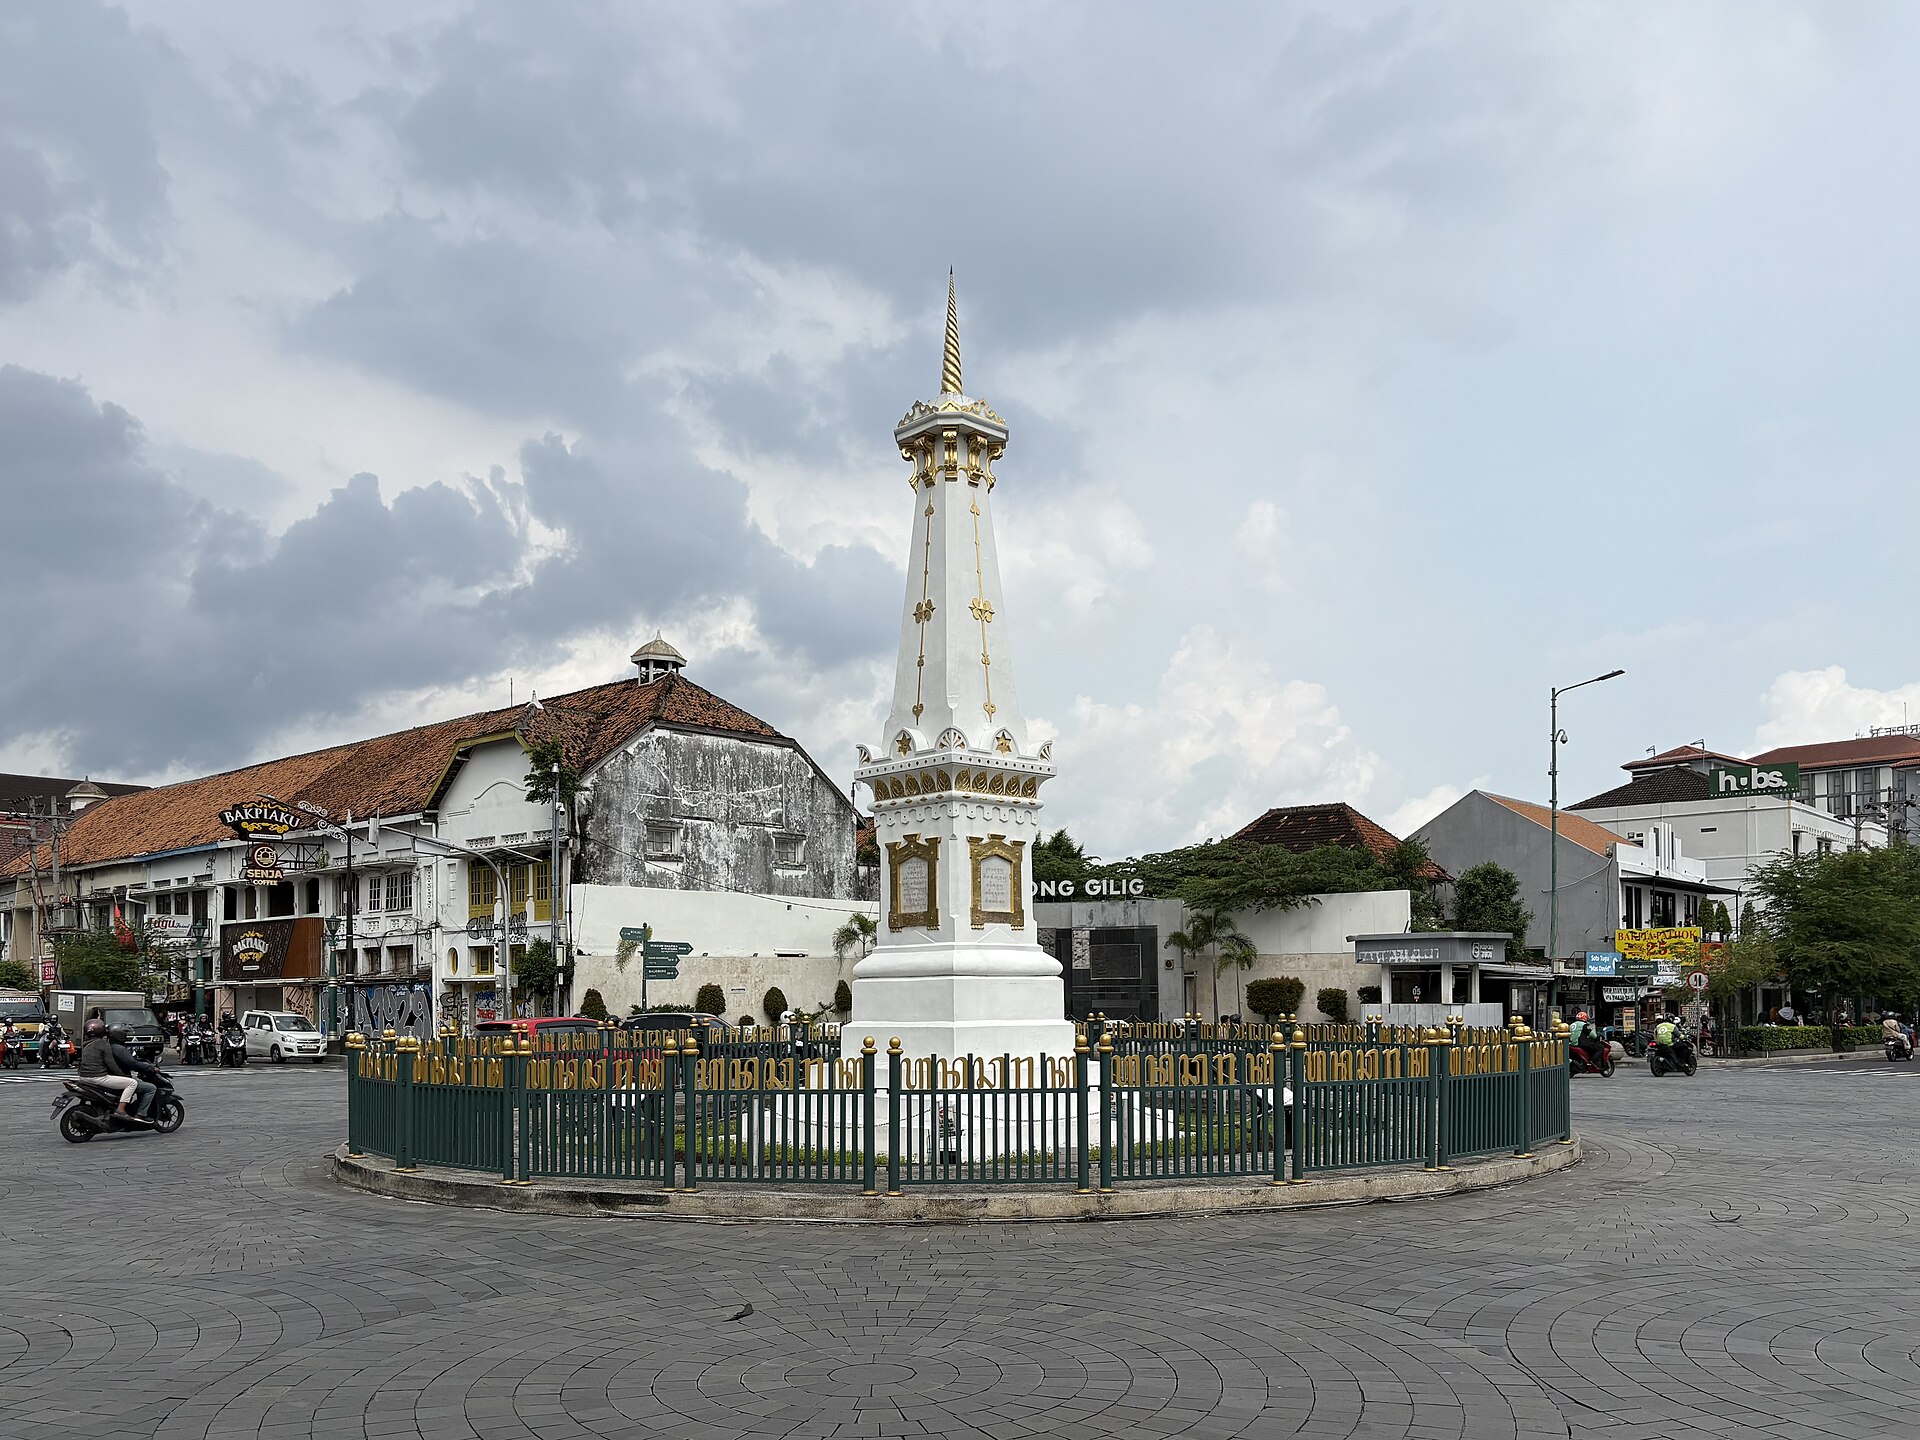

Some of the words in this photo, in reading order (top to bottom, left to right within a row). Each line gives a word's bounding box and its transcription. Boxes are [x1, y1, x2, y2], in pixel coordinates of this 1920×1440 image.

[224, 807, 300, 827] BAKPIAKU
[246, 869, 283, 879] SENJA
[1084, 879, 1145, 895] GILIG
